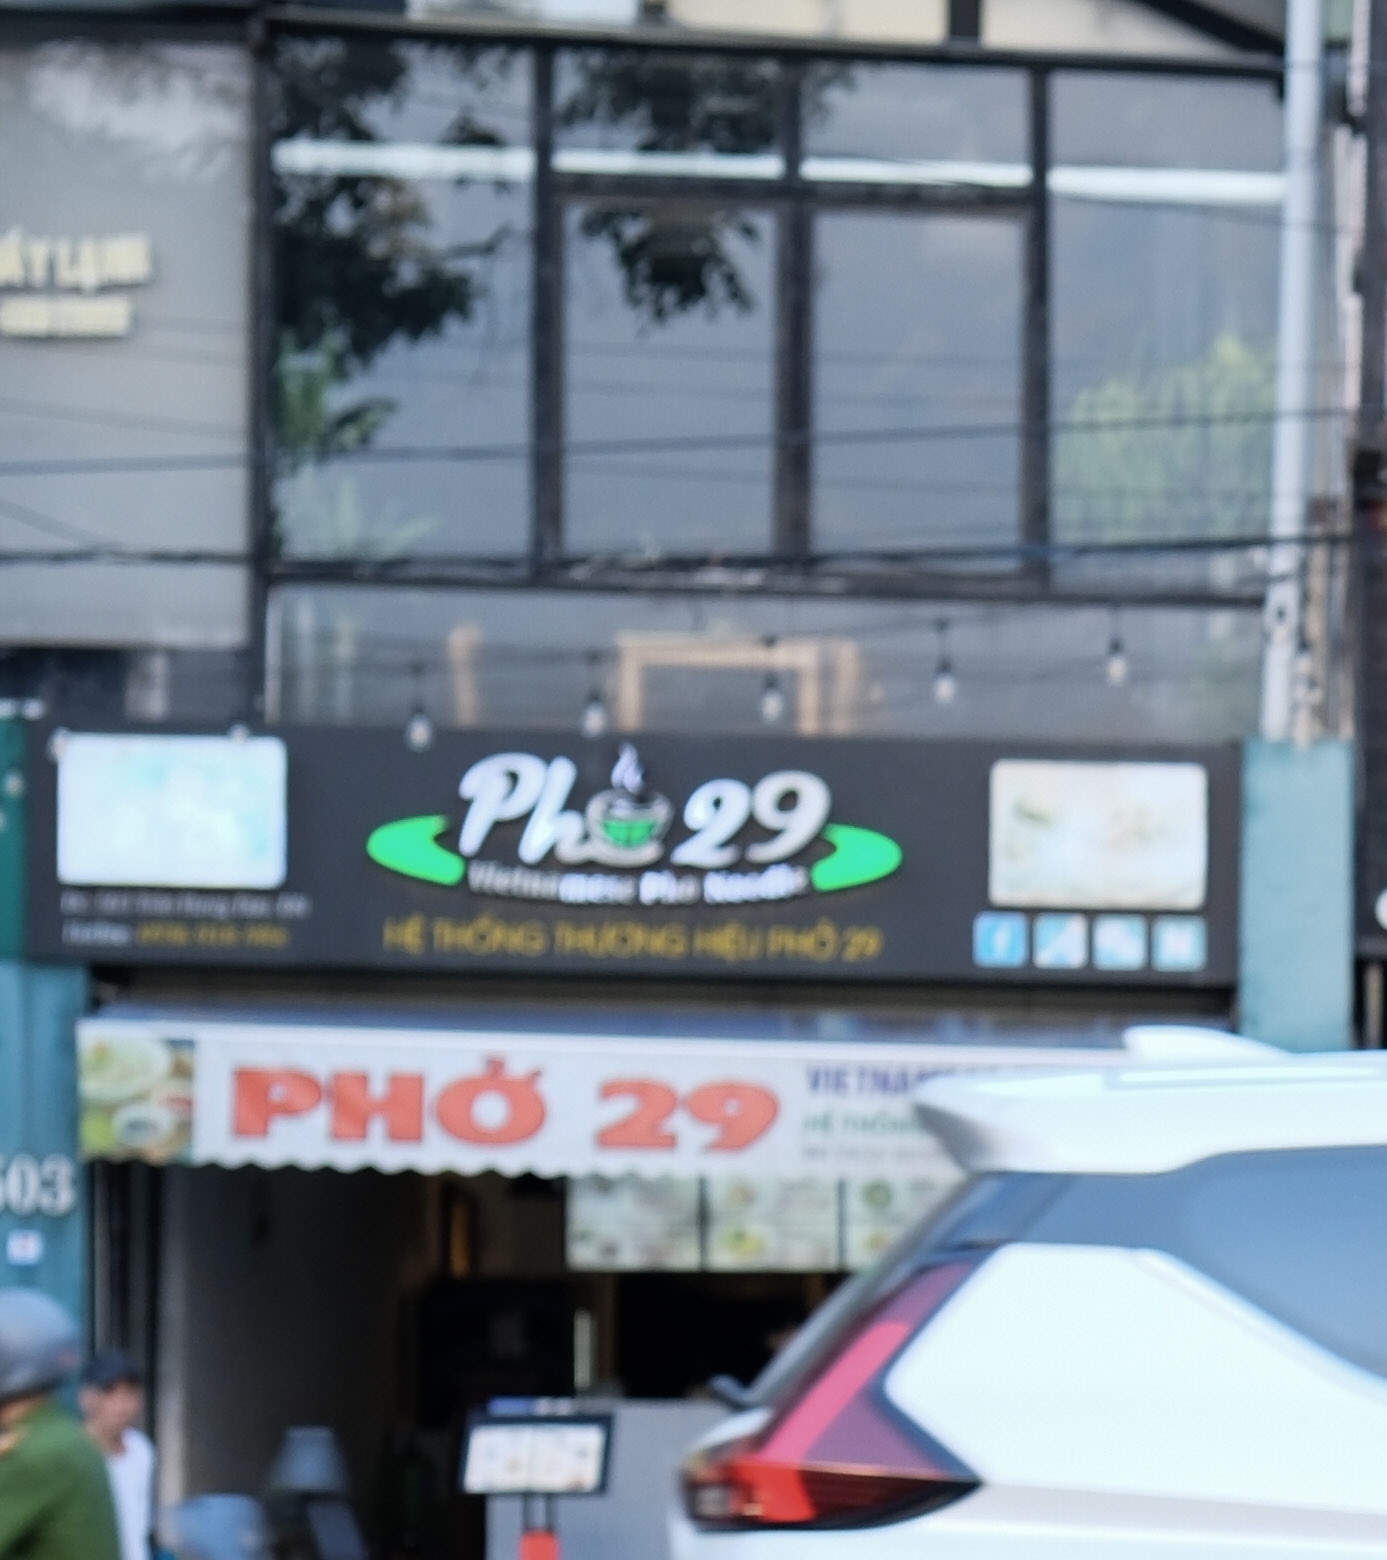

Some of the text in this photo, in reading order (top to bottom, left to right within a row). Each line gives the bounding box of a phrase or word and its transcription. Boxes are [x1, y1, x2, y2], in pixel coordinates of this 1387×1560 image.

[669, 770, 832, 869] 29
[233, 1054, 781, 1154] PHỞ 29
